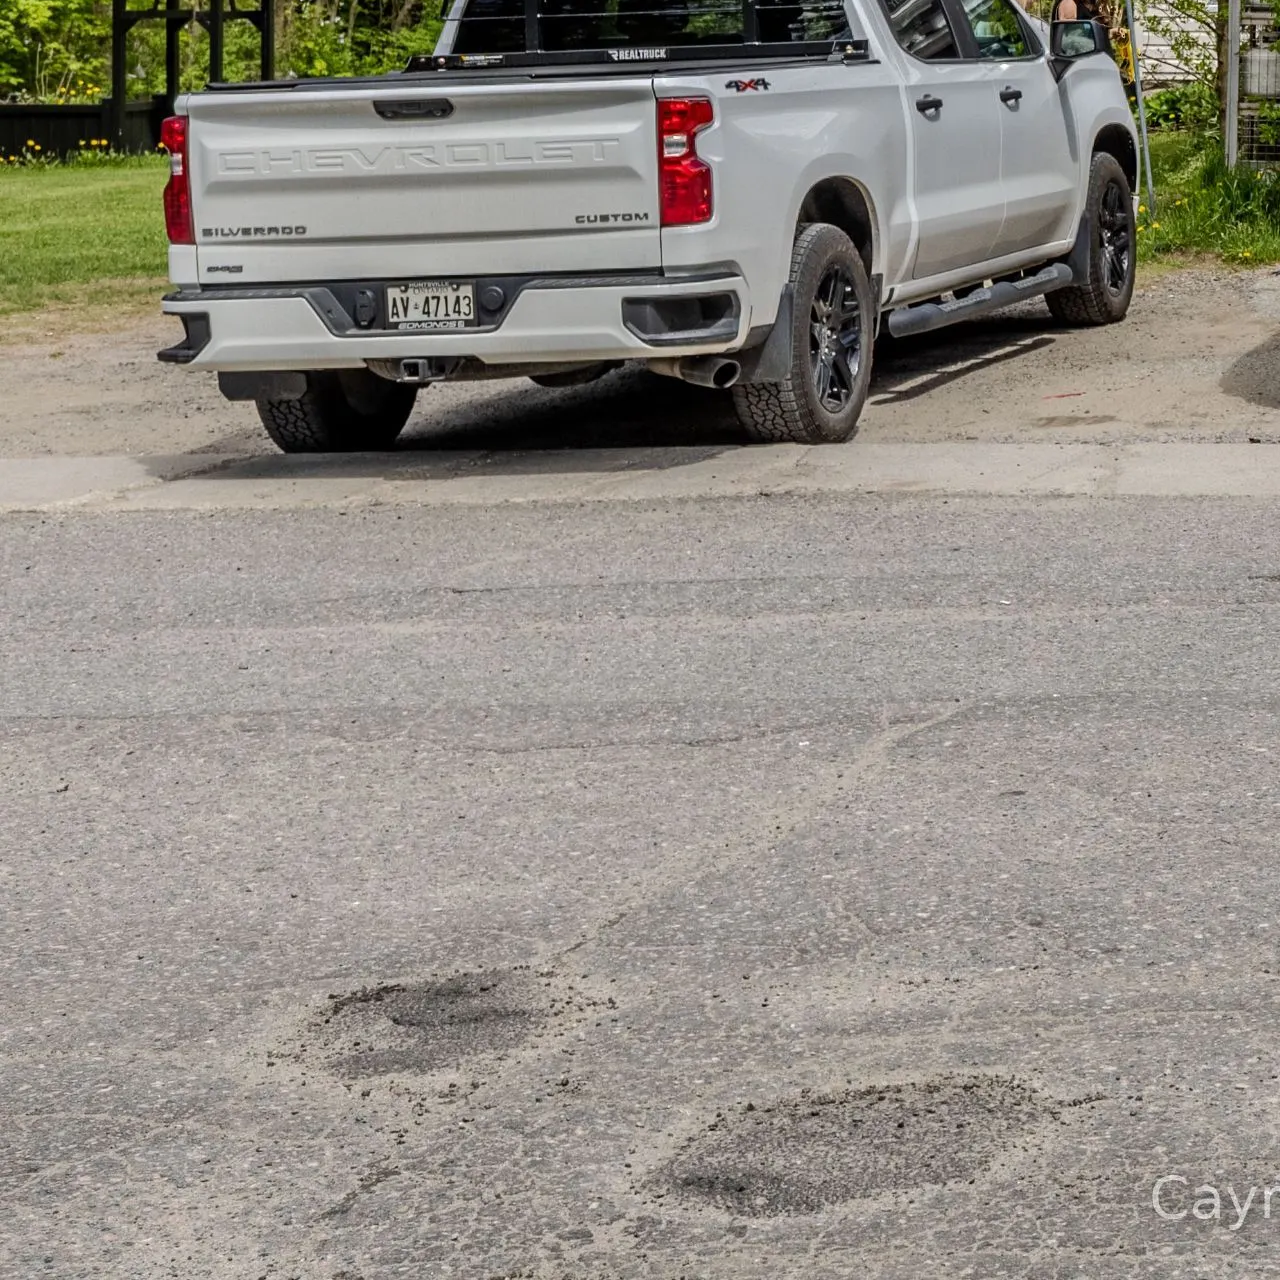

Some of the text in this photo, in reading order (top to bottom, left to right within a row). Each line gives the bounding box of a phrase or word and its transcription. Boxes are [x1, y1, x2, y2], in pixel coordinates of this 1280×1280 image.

[619, 49, 667, 61] REALTRUCK
[217, 138, 620, 175] CHEVROLET
[574, 212, 650, 224] CUSTOM
[201, 225, 308, 237] SILVERADO
[413, 287, 449, 295] ONTARIO
[391, 295, 472, 319] AV 47143
